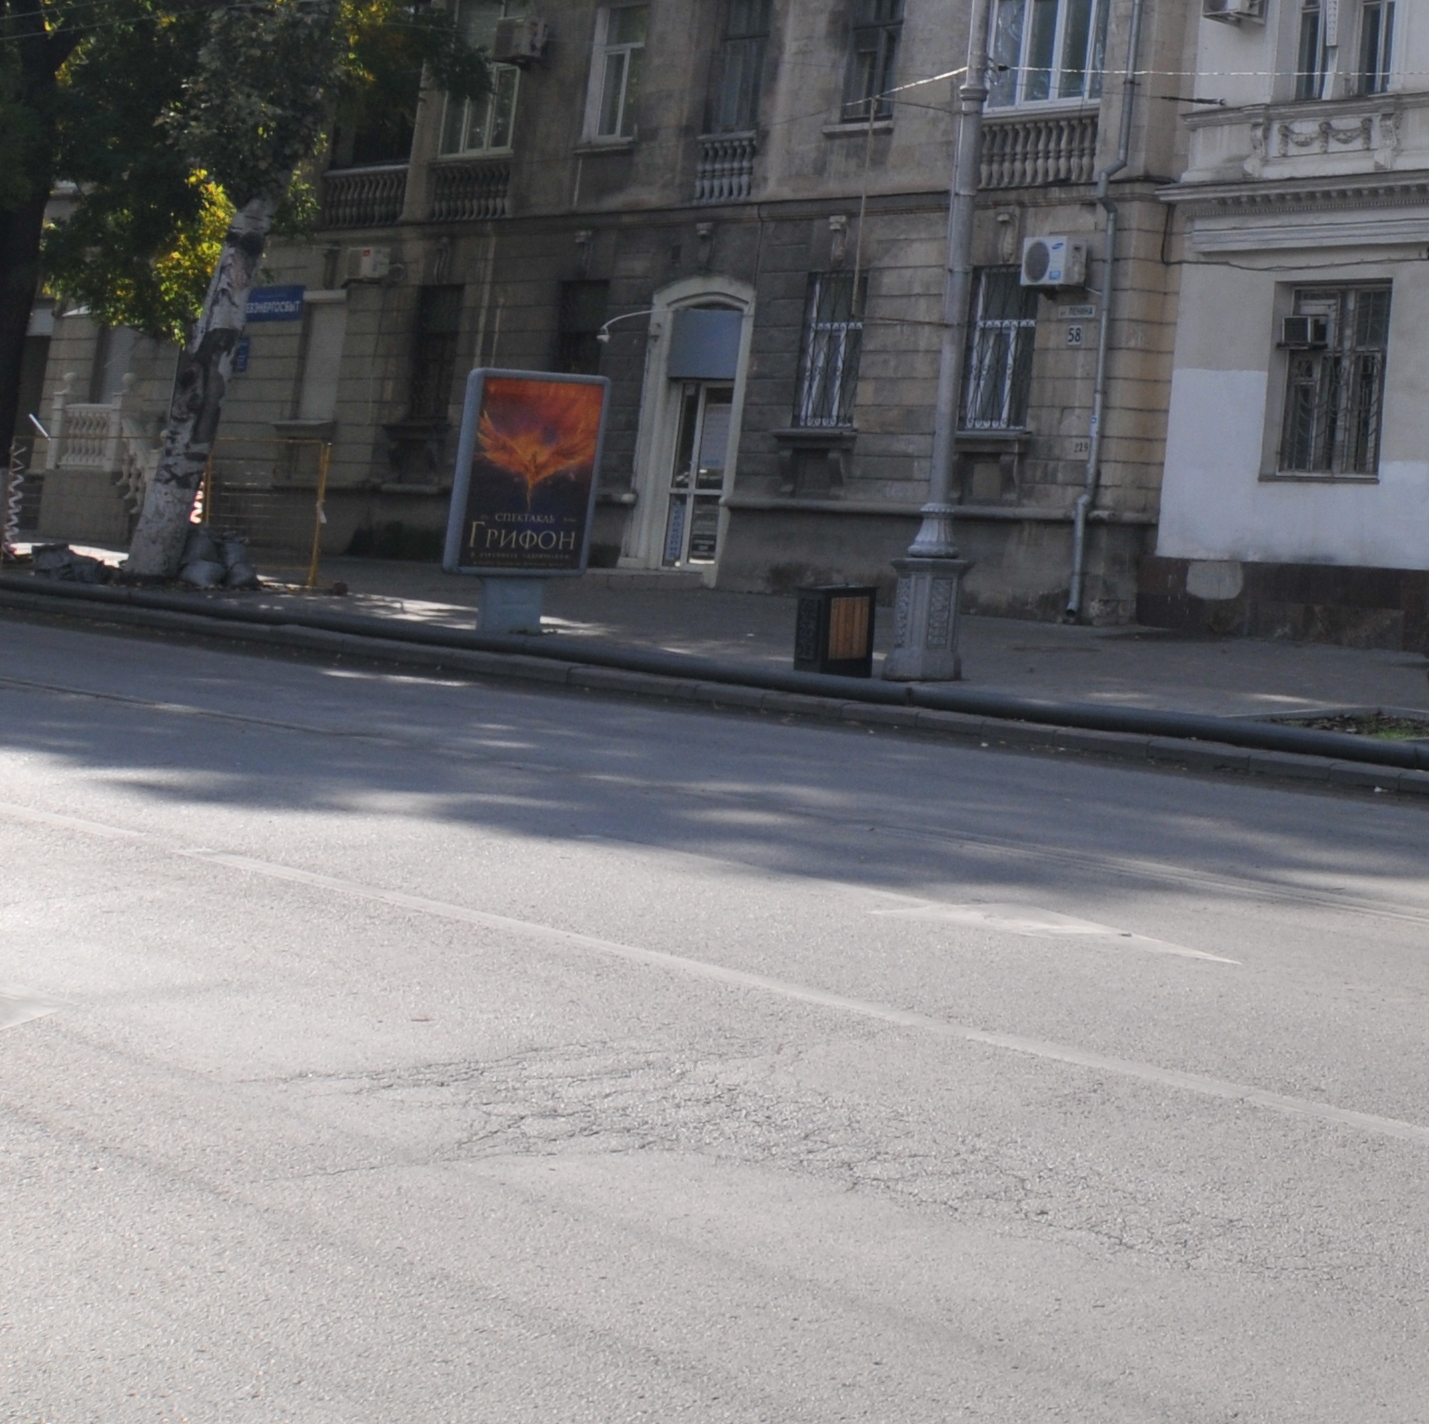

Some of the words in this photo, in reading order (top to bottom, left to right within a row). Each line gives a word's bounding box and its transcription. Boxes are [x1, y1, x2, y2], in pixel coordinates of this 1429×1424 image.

[246, 300, 301, 314] ЕВЭНЕРГОСБЫТ
[1067, 327, 1082, 343] 58
[494, 512, 556, 524] СПЕКТАКЛЬ
[468, 520, 577, 551] ГРИФОН
